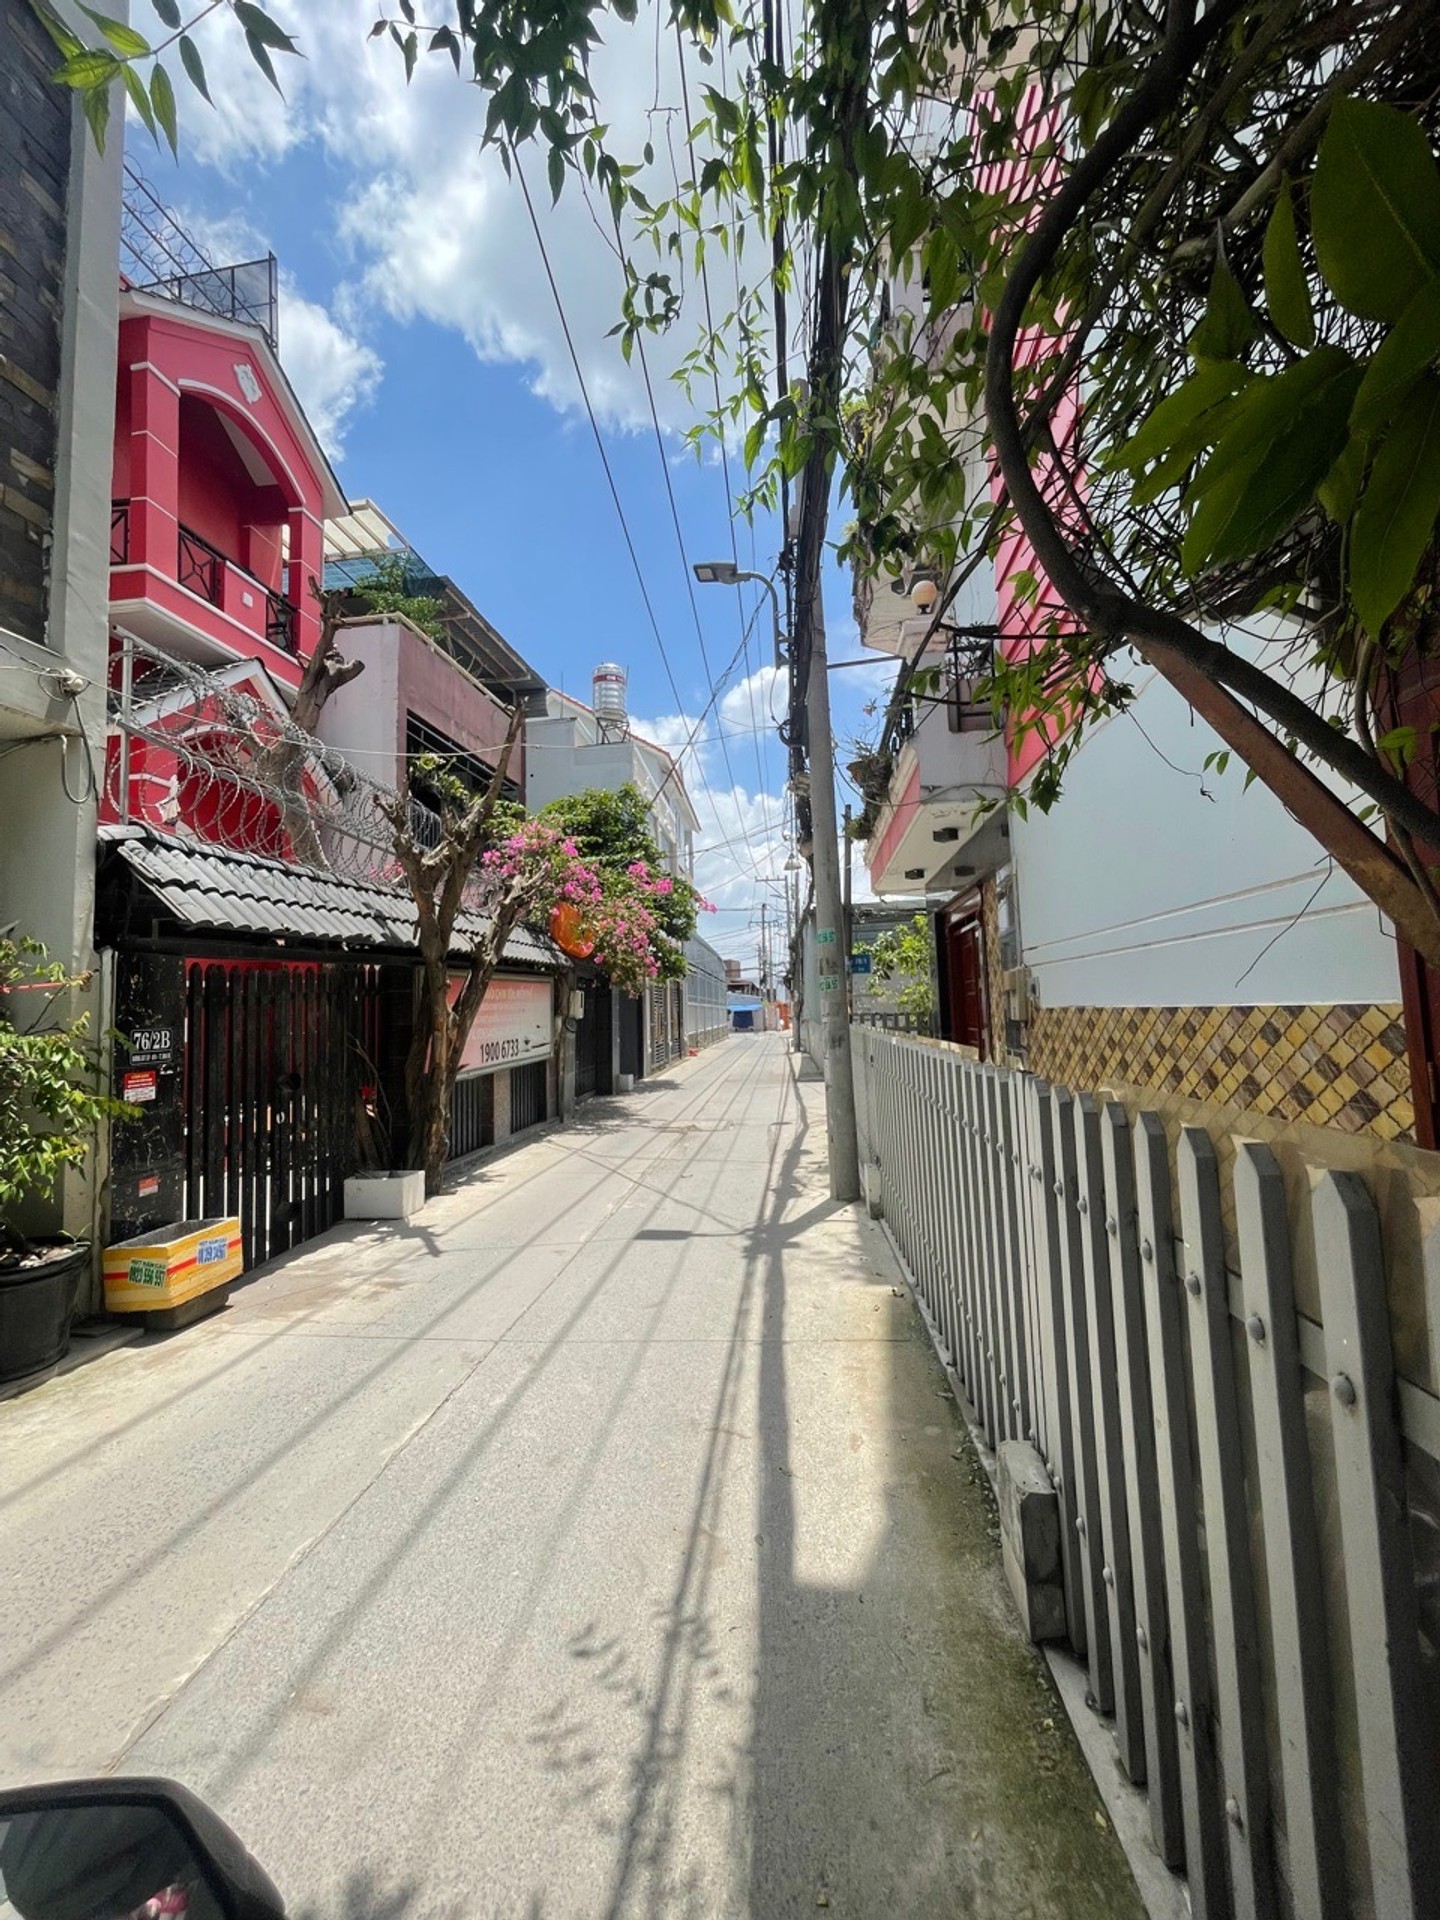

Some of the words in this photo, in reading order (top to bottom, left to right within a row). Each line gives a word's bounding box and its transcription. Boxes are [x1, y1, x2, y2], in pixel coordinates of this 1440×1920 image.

[133, 1030, 171, 1050] 76/2B
[480, 1041, 500, 1063] 1900
[501, 1038, 519, 1059] 6733
